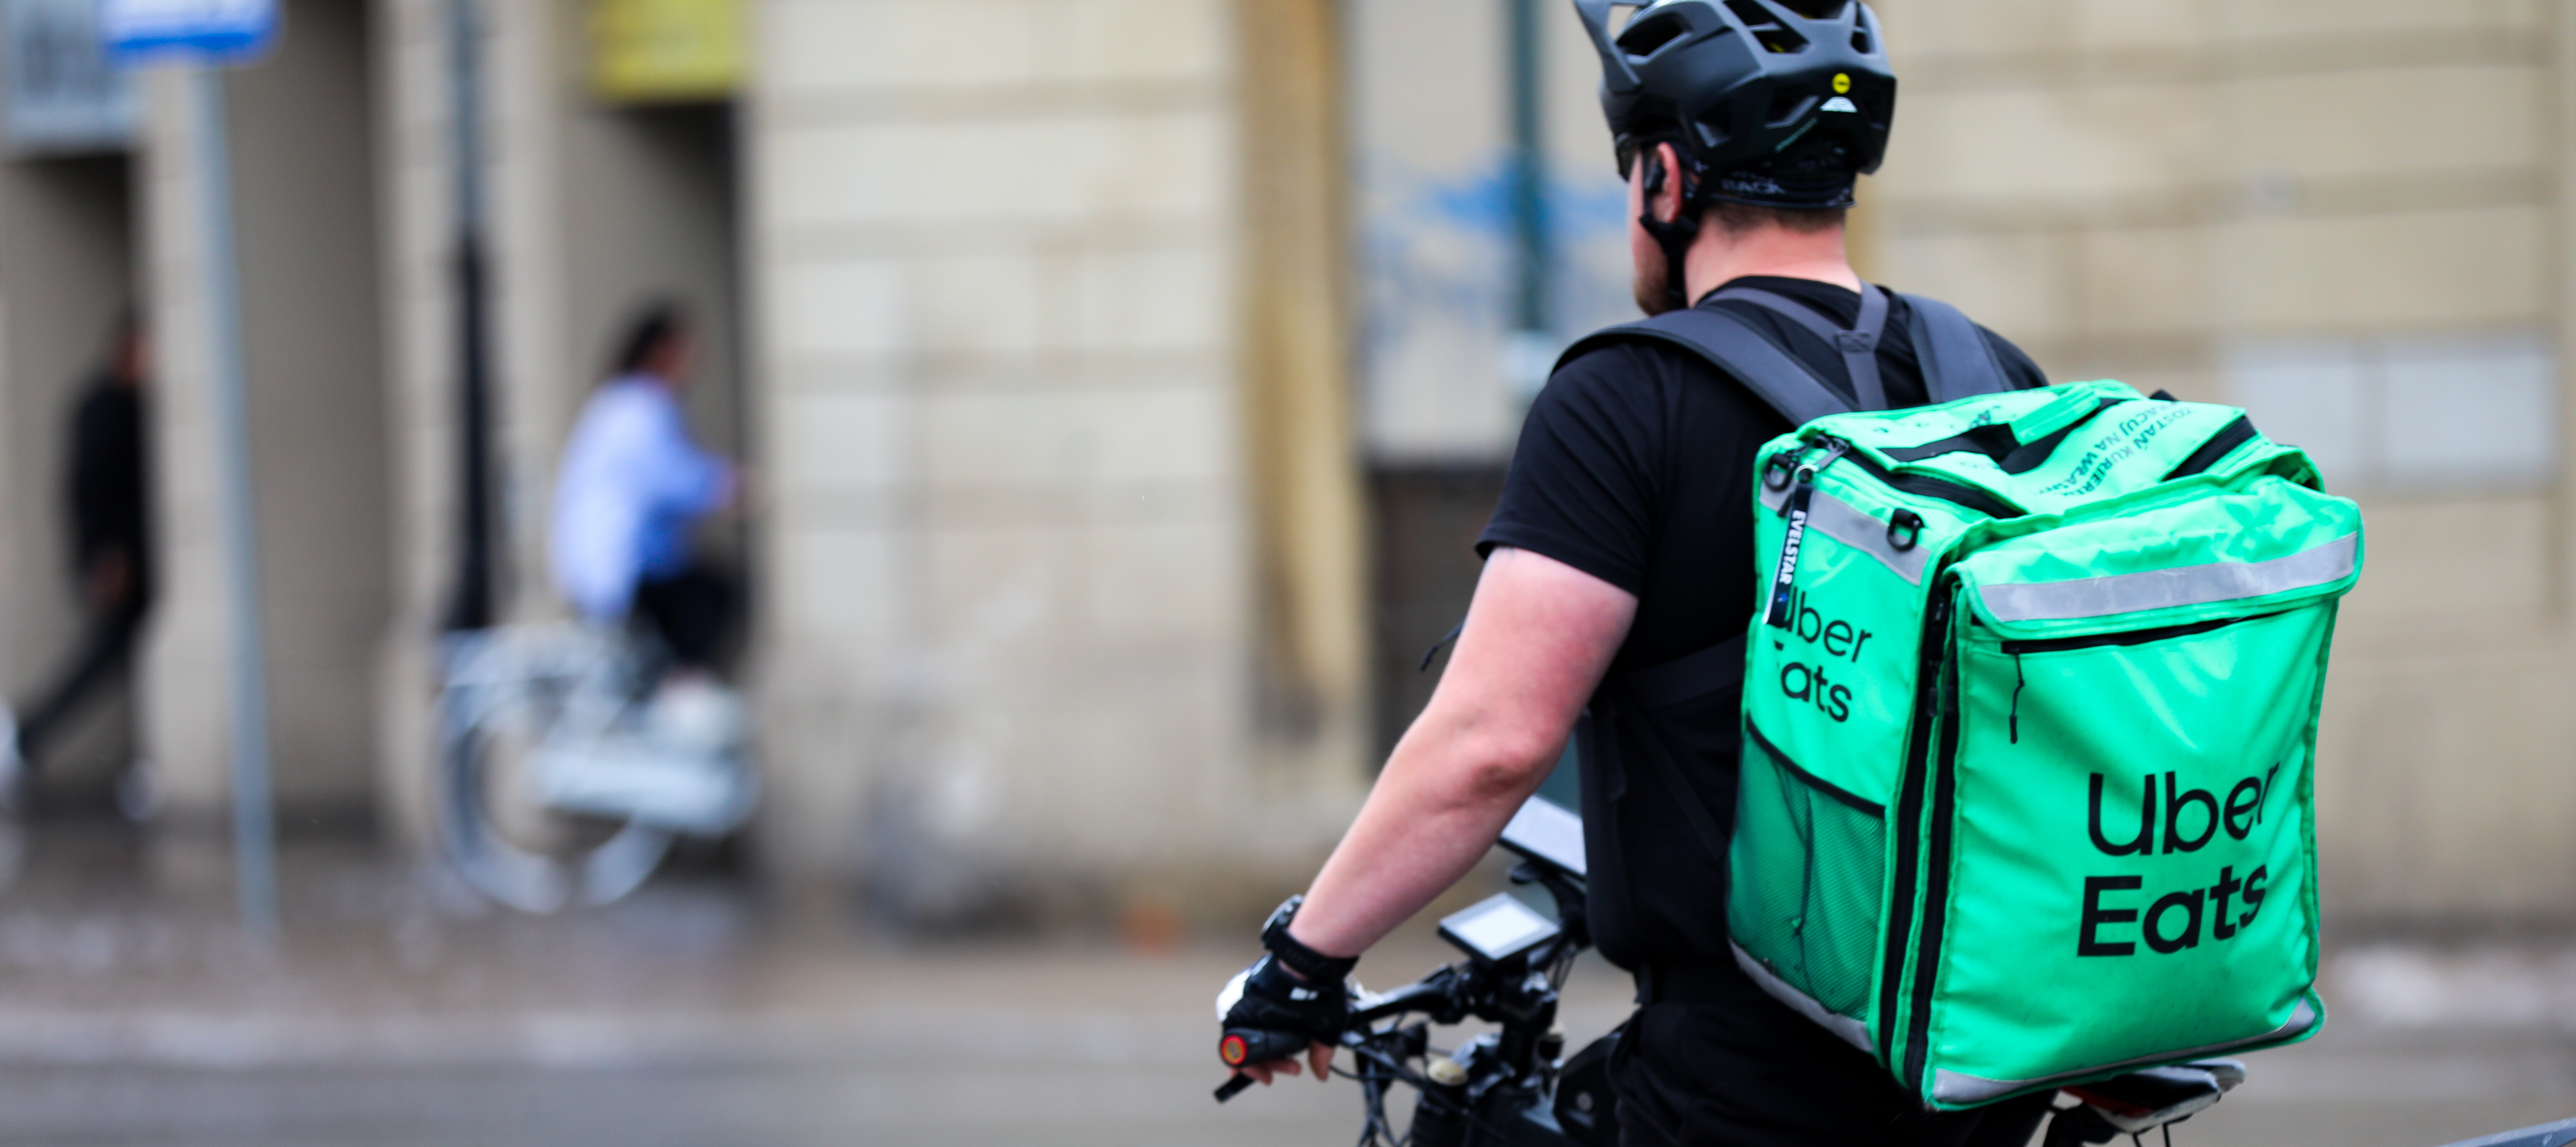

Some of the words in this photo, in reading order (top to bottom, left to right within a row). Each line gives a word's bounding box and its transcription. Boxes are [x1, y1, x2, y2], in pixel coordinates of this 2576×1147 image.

[1779, 509, 1807, 585] EVELSTAR
[1775, 641, 1852, 723] ats
[2087, 761, 2280, 857] Uber
[2077, 864, 2268, 957] Eats
